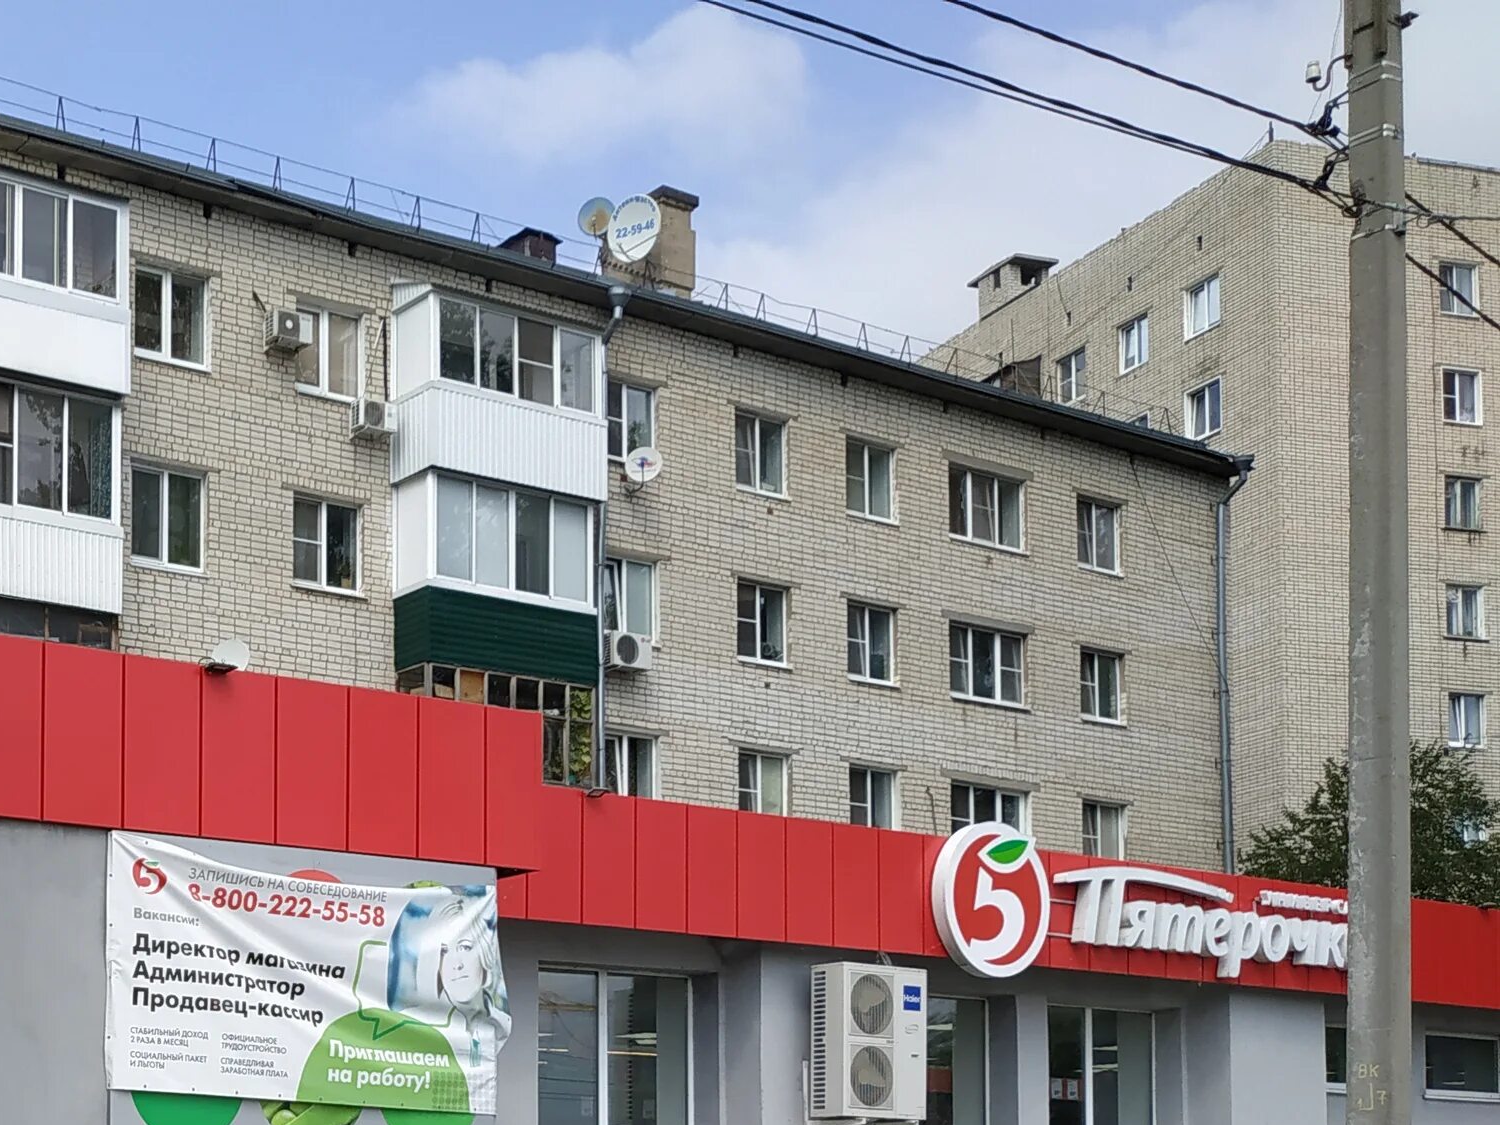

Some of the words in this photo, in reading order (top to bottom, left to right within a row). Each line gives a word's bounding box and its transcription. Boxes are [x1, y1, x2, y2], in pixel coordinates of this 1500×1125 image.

[615, 218, 655, 239] 22-59-46
[188, 867, 265, 888] ЗАПИШИСЬ
[267, 878, 285, 891] НА
[287, 881, 388, 902] СОБЕСЕДОВАНИЕ
[187, 883, 385, 927] 8-800-222-55-58
[133, 907, 200, 926] Вакансии:
[1053, 866, 1348, 978] Пятерочк
[132, 933, 240, 965] Директор
[245, 952, 346, 979] магазина
[132, 960, 306, 1000] Администратор
[131, 987, 324, 1027] Продавец-кассир
[902, 994, 921, 1004] Haier
[130, 1026, 180, 1037] СТАБИЛЬНЫЙ
[181, 1030, 209, 1040] ДОХОД
[136, 1036, 156, 1044] РАЗА
[157, 1037, 162, 1045] В
[163, 1038, 189, 1048] МЕСЯЦ
[221, 1033, 277, 1045] ОФИЦИАЛЬНОЕ
[130, 1050, 184, 1062] СОЦИАЛЬНЫЙ
[185, 1055, 208, 1063] ПАКЕТ
[221, 1042, 287, 1055] ТРУДОУСТРОЙСТВО
[328, 1039, 450, 1067] Приглашаем
[137, 1060, 165, 1069] ЛЬГОТЫ
[220, 1057, 274, 1068] СПРАВЕДЛИВАЯ
[220, 1066, 264, 1077] ЗАРАБОТНАЯ
[265, 1069, 289, 1078] ПЛАТА
[327, 1068, 352, 1083] на
[356, 1067, 431, 1093] работу!
